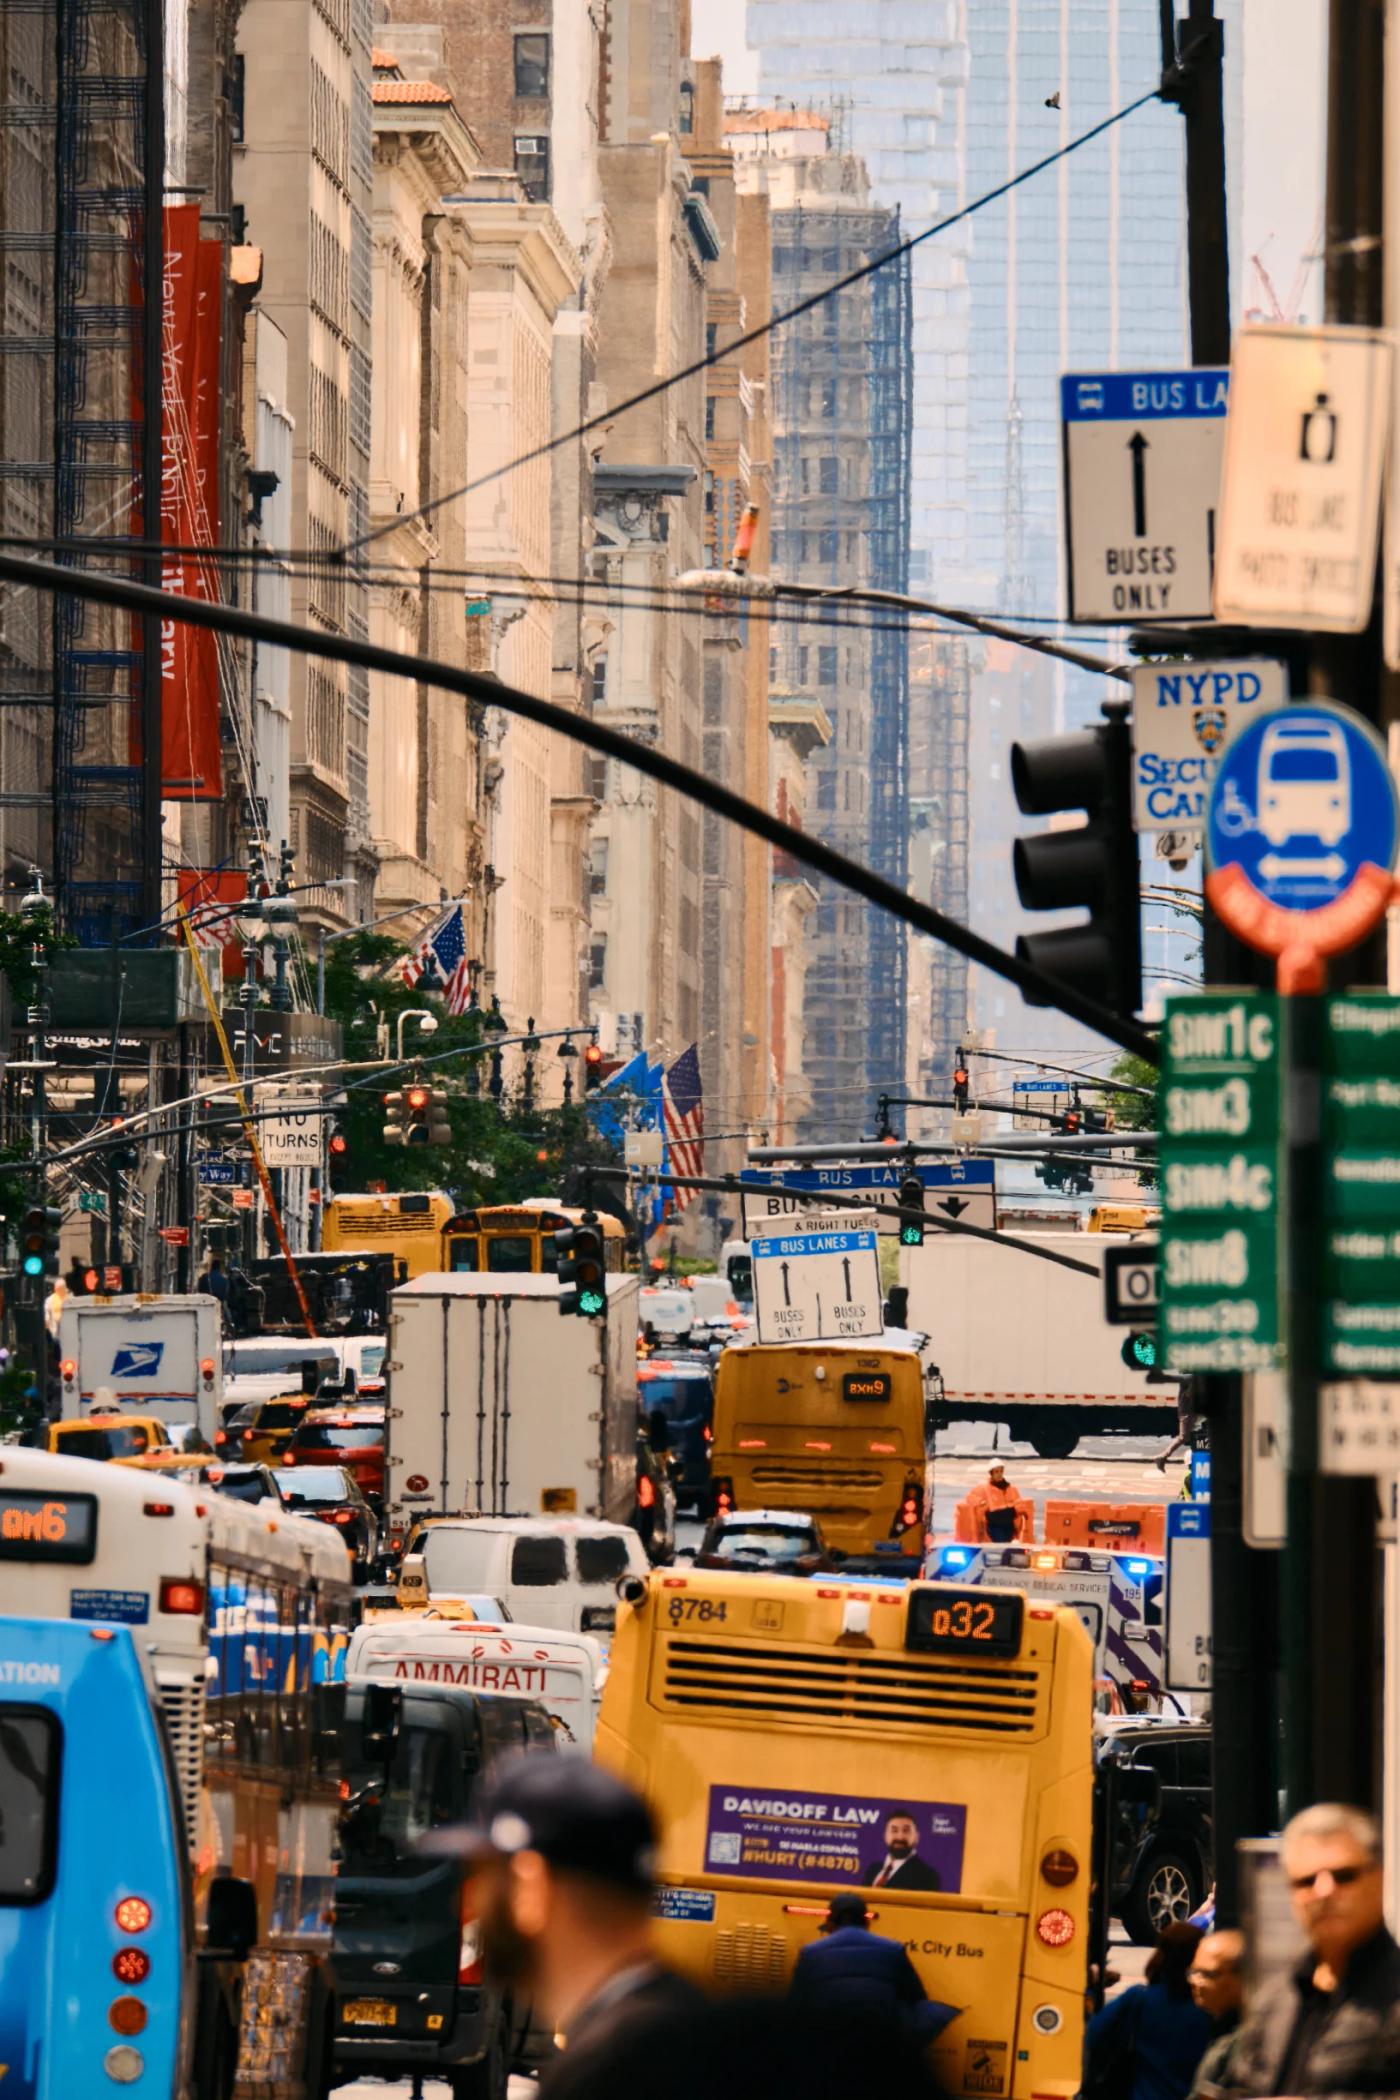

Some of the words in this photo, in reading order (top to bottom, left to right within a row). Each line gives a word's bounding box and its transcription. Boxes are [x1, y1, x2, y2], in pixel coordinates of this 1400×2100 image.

[1132, 382, 1186, 411] BUS
[1106, 546, 1177, 575] BUSES
[1112, 583, 1172, 612] ONLY
[1155, 672, 1262, 707] NYPD
[266, 1133, 319, 1149] TURNS
[806, 1219, 839, 1231] RIGHT
[780, 1240, 805, 1252] BUS
[808, 1236, 848, 1251] LANES
[773, 1309, 805, 1324] BUSES
[833, 1305, 867, 1318] BUSES
[838, 1321, 864, 1334] ONLY
[1069, 1582, 1108, 1594] SERVICES
[1124, 1588, 1142, 1600] 195
[668, 1597, 728, 1622] 8784
[394, 1660, 546, 1692] AMMIRATI
[724, 1796, 828, 1820] DAVIDOFF
[833, 1806, 880, 1824] LAW
[922, 1940, 953, 1957] City
[956, 1943, 984, 1958] Bus
